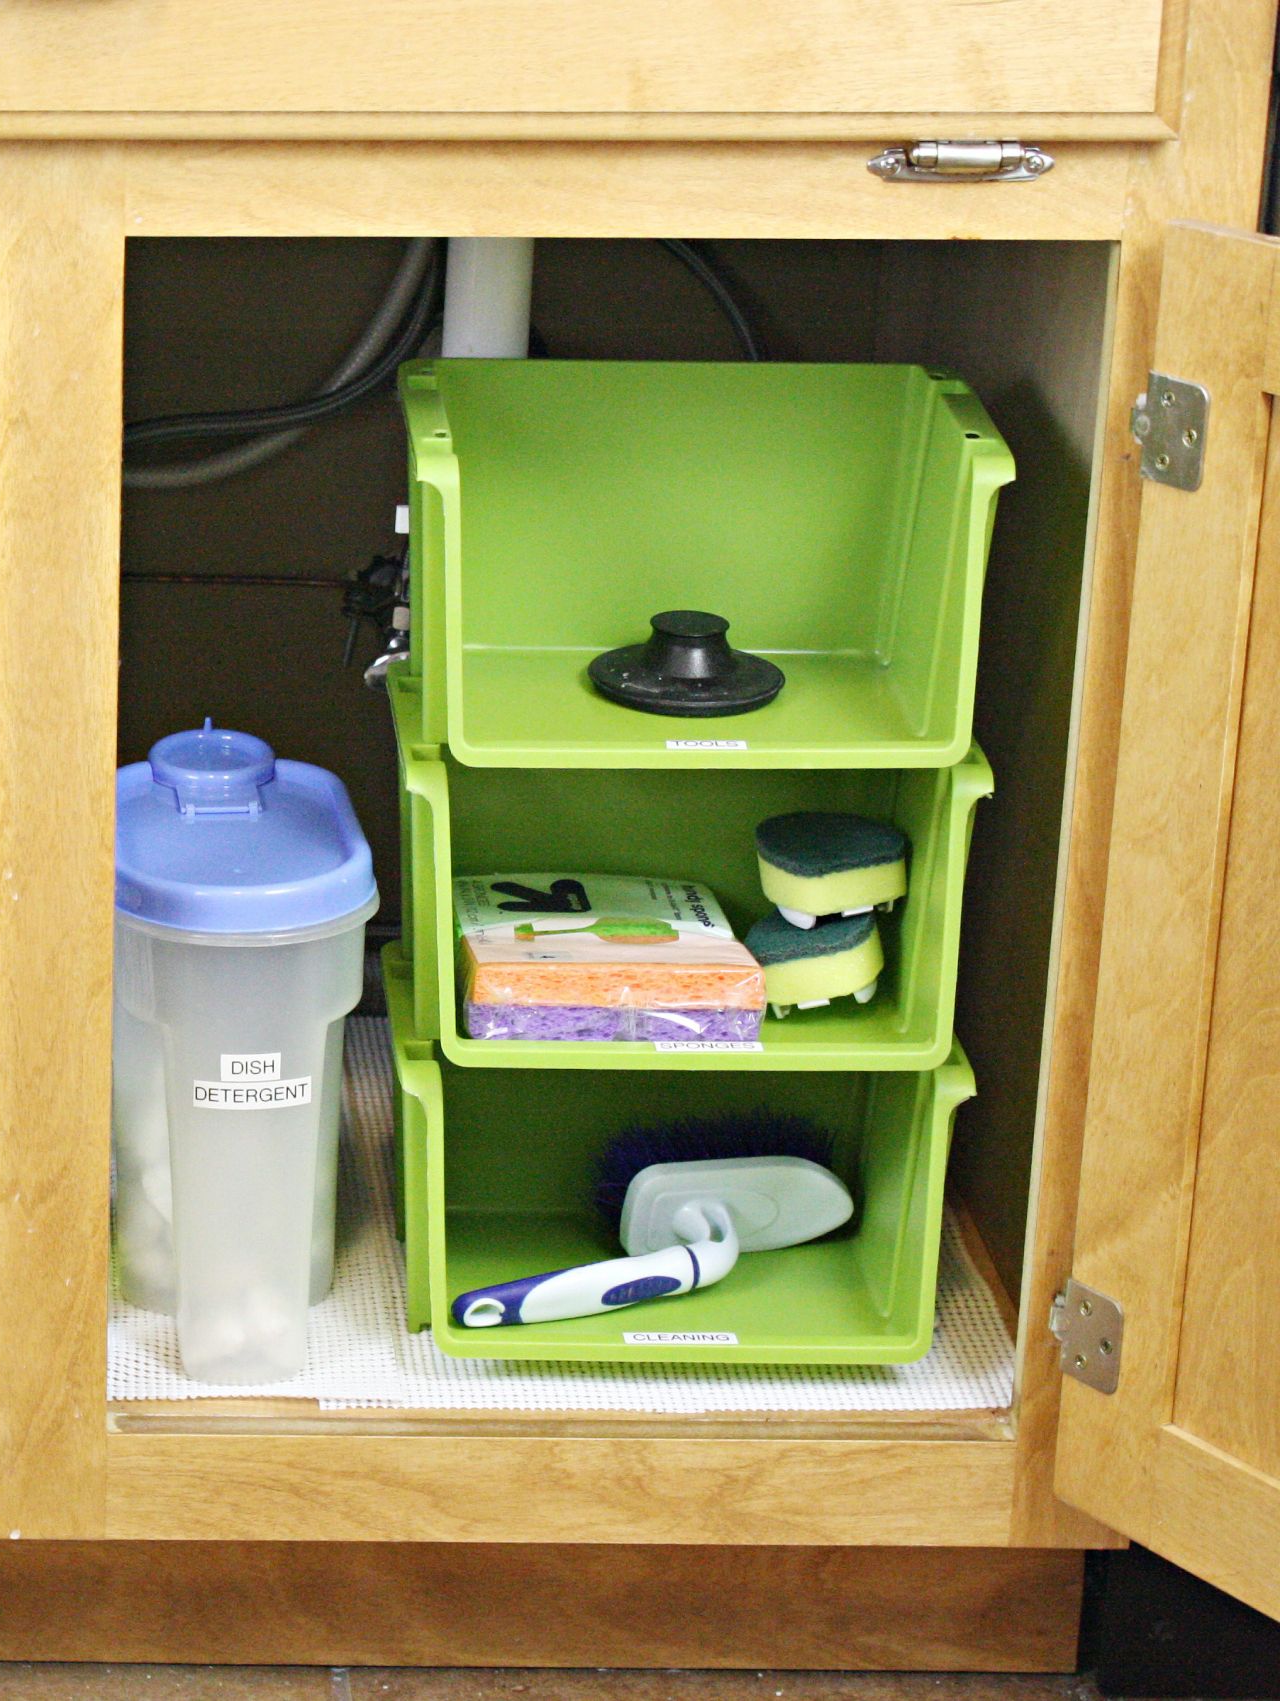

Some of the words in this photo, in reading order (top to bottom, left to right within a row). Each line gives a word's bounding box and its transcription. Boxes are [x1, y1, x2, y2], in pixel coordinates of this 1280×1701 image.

[672, 740, 739, 748] TOOLS
[659, 1042, 756, 1050] SPONGES
[230, 1059, 276, 1075] DISH
[194, 1083, 309, 1104] DETERGENT
[632, 1333, 731, 1342] CLEANING
